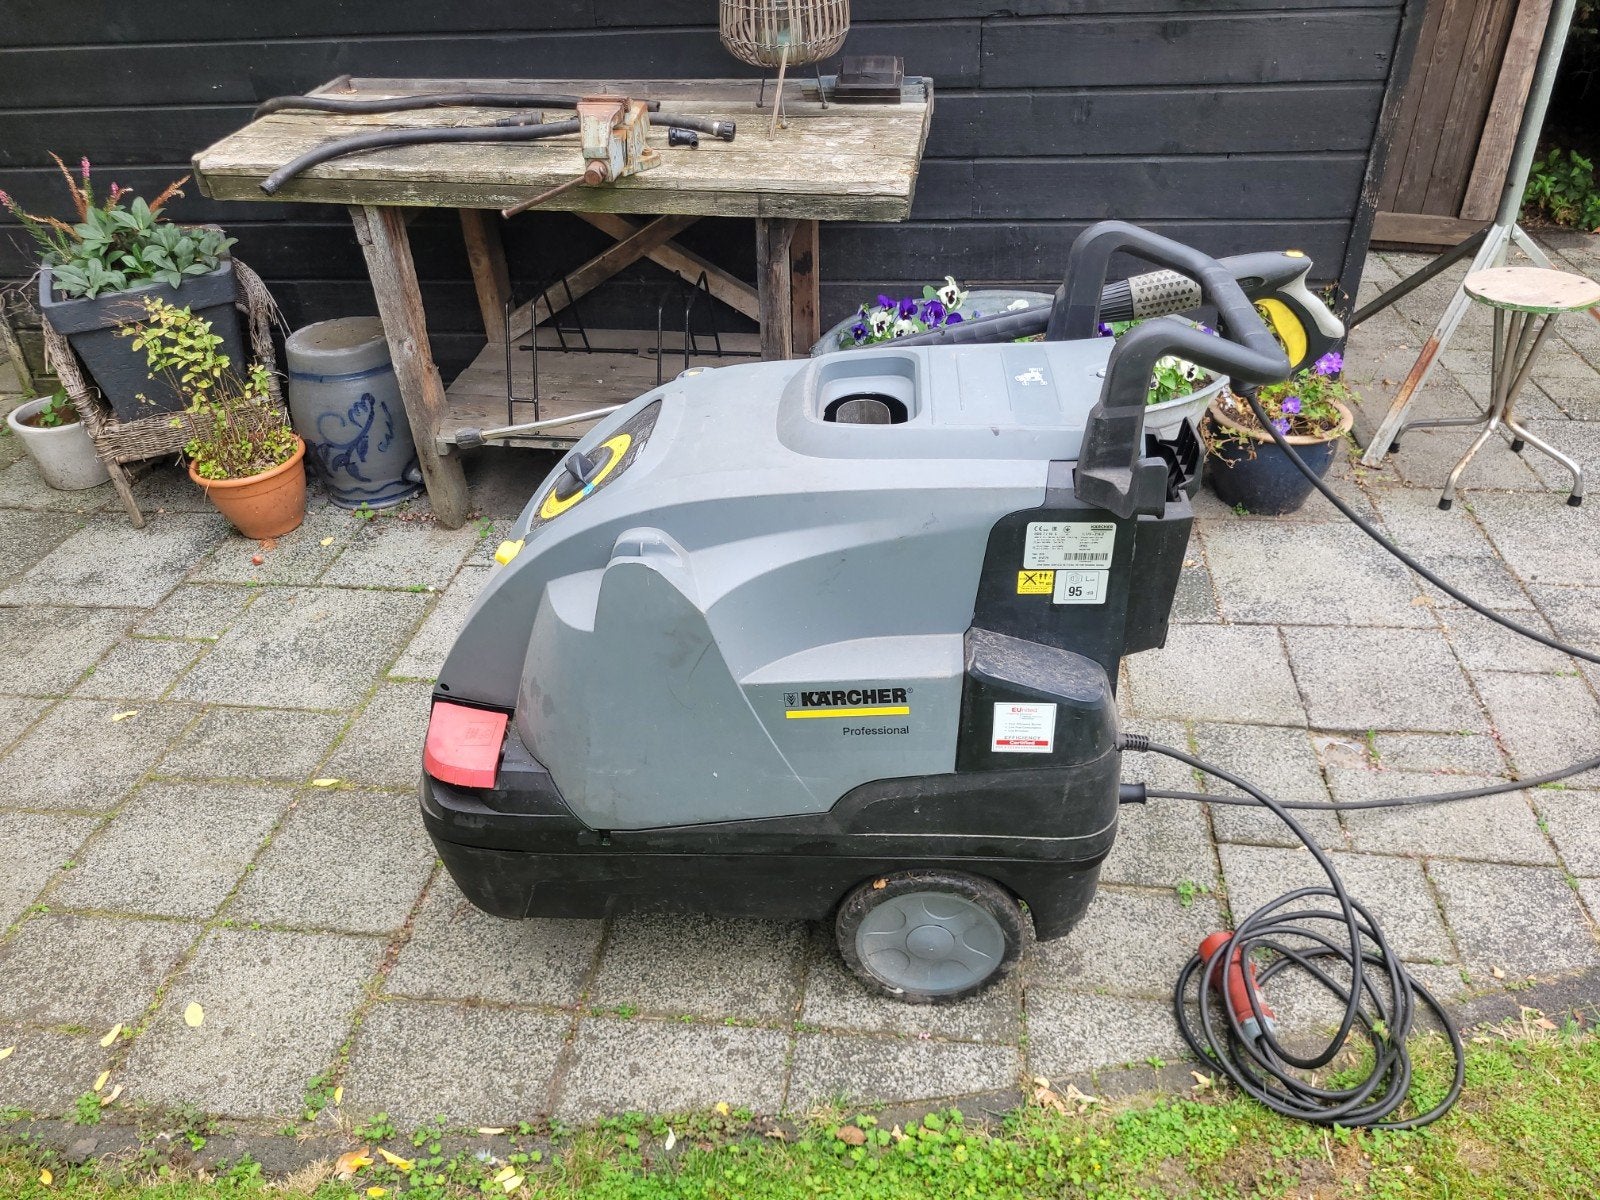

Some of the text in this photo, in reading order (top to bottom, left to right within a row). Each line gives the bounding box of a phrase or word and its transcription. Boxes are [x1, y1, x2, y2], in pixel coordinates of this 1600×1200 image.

[1068, 586, 1082, 597] 95
[801, 688, 908, 707] KÄRCHER
[842, 726, 910, 736] Professional
